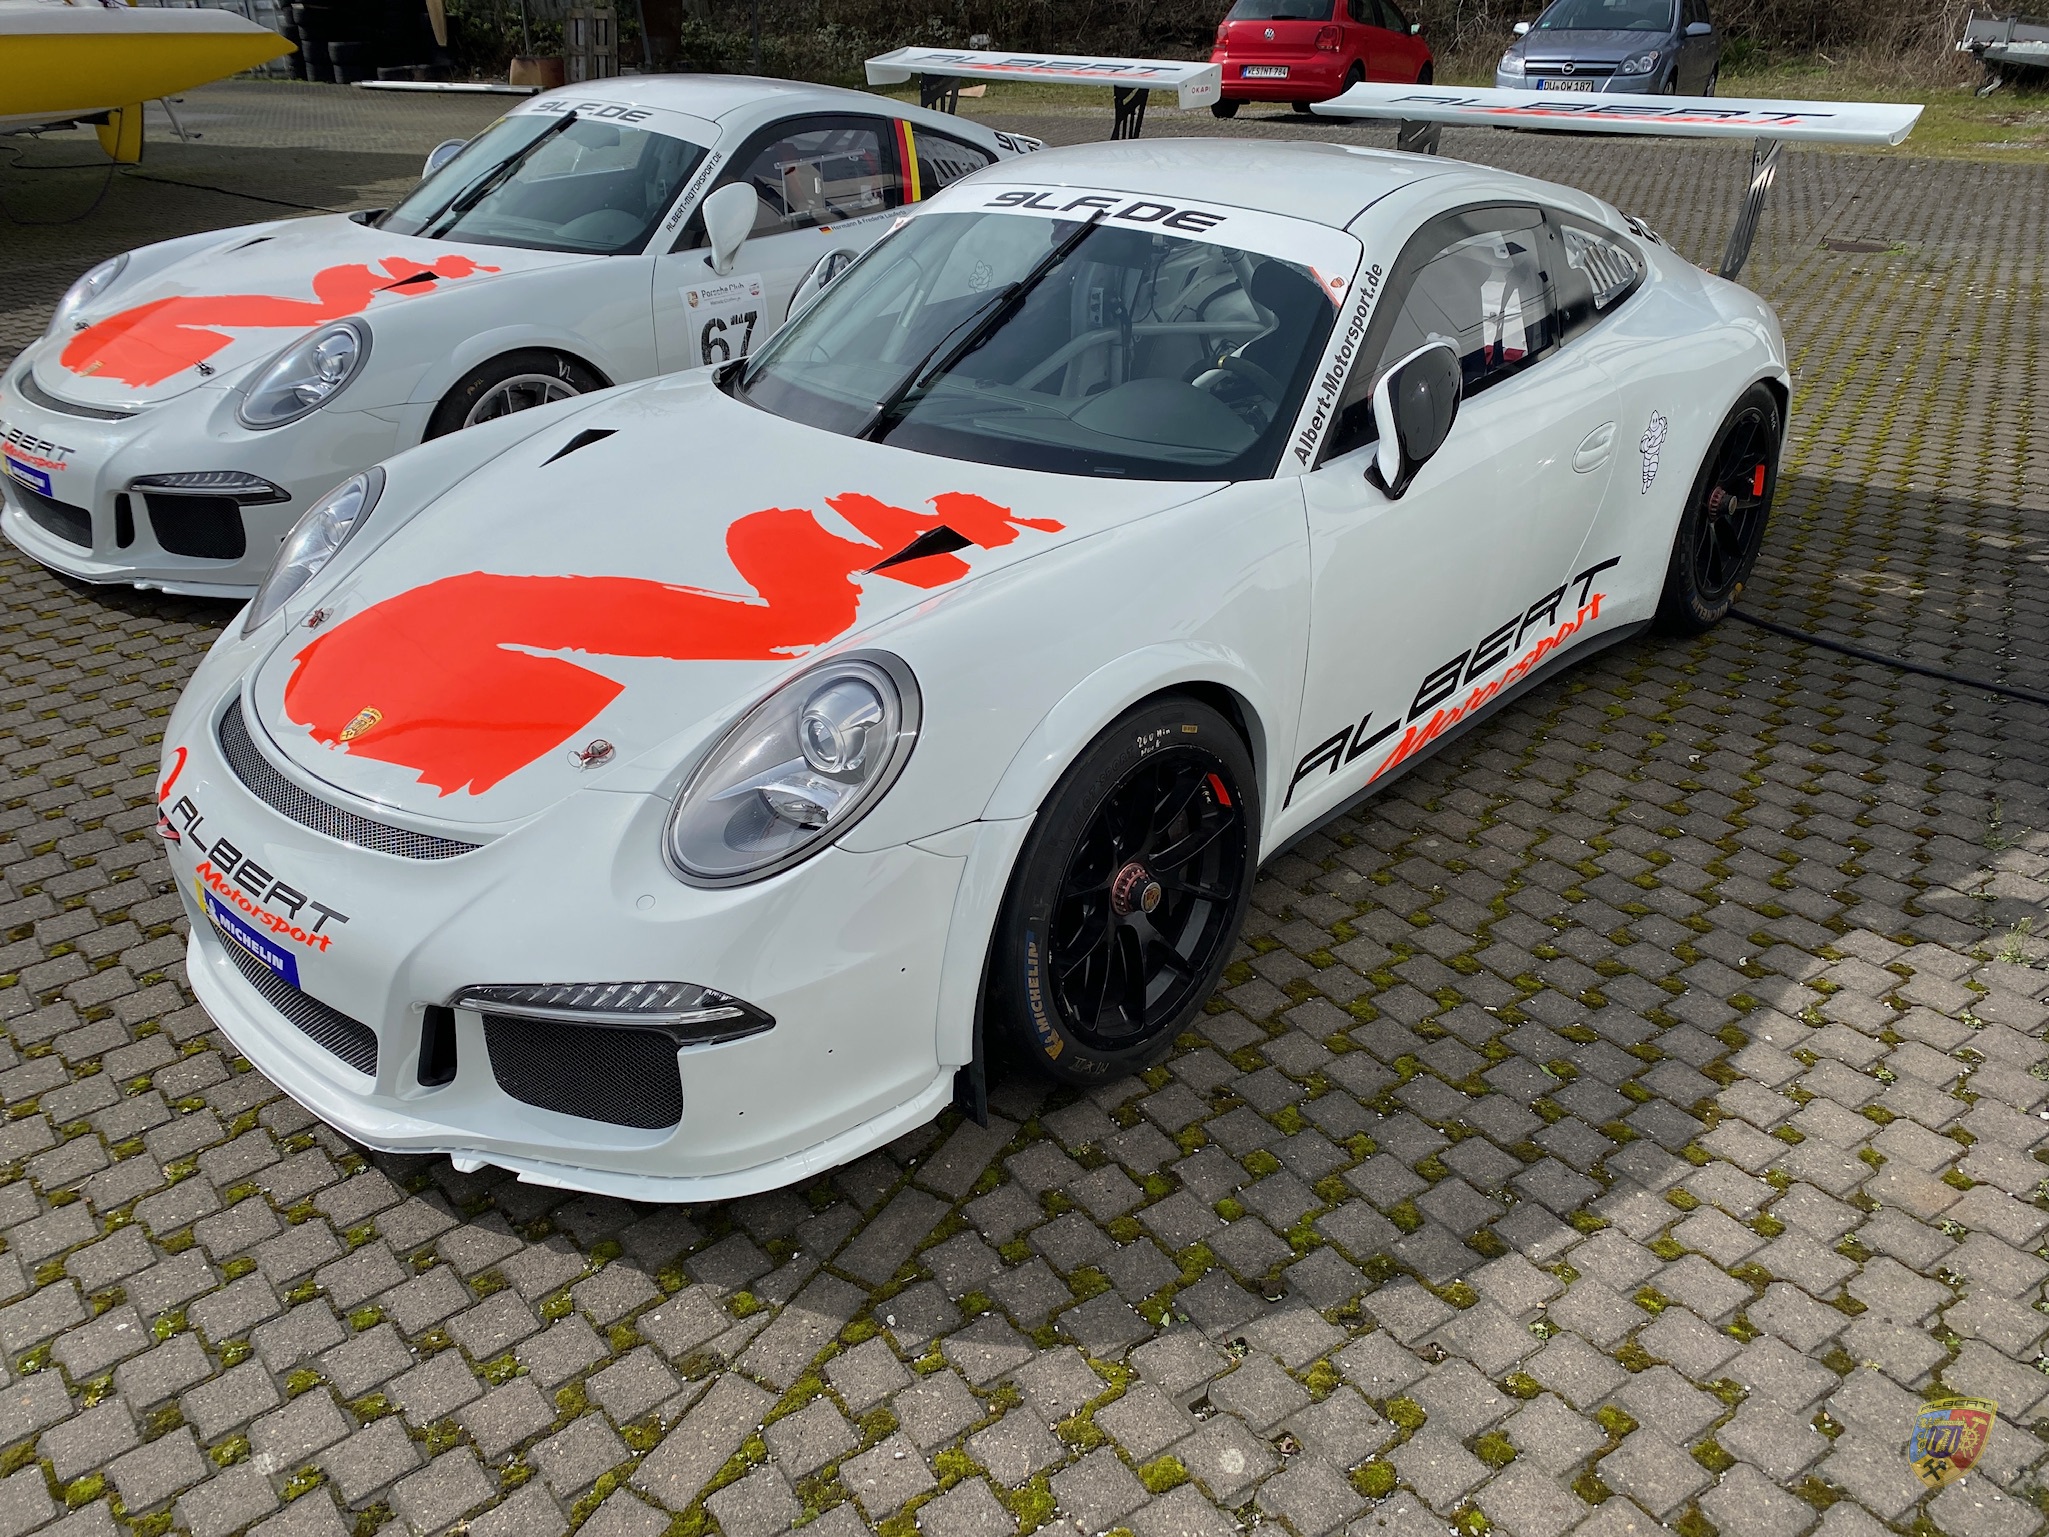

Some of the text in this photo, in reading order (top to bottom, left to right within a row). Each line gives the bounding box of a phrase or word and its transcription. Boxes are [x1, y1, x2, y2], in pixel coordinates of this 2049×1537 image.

[914, 54, 1183, 75] ALBERT
[1191, 86, 1211, 94] OKAPI
[1544, 81, 1556, 90] DU
[1574, 82, 1591, 91] 187
[1387, 95, 1837, 121] ALBERT
[666, 151, 722, 233] ALBERT-MOTORSPORT.DE
[701, 310, 758, 366] 67
[1293, 263, 1383, 467] Albert-Motorsport.de
[1282, 554, 1622, 812] ALBERT
[1366, 593, 1607, 787] Motorsport
[172, 796, 350, 934] ALBERT
[196, 861, 333, 953] Motorsport
[219, 914, 284, 972] MICHELIN
[1028, 941, 1051, 1033] MICHELIN
